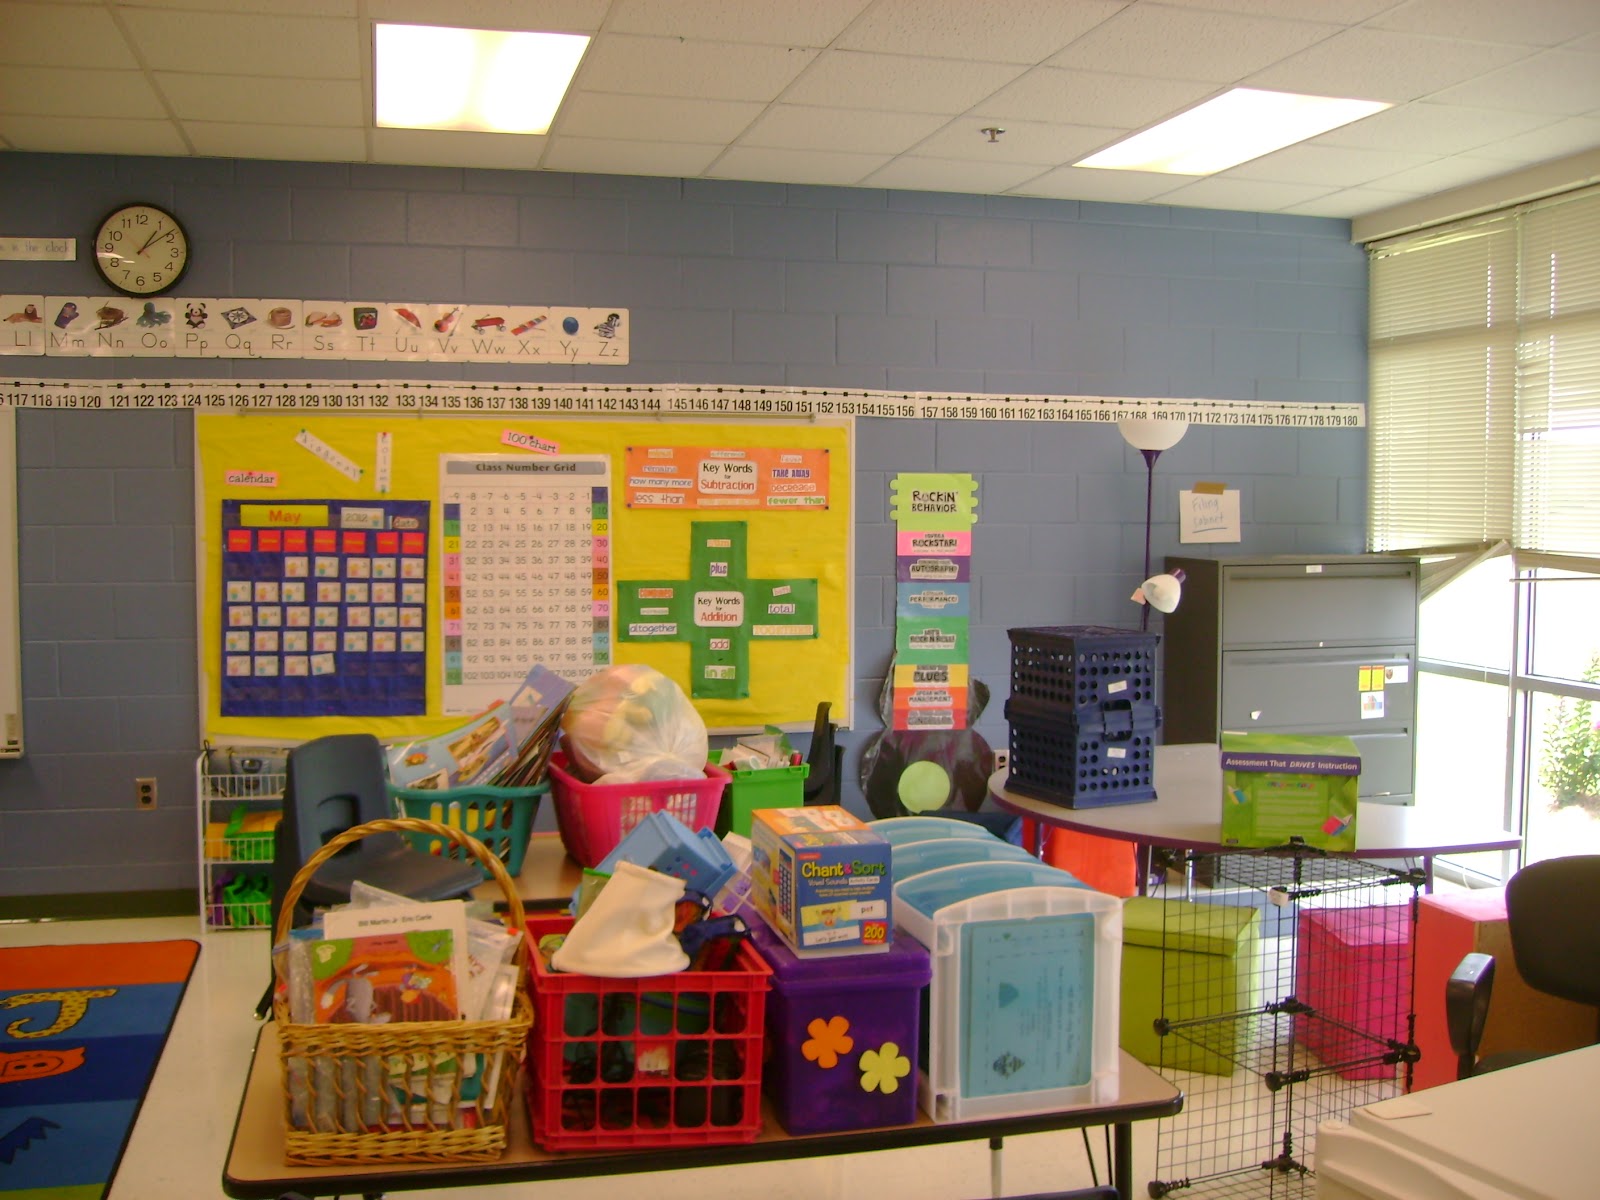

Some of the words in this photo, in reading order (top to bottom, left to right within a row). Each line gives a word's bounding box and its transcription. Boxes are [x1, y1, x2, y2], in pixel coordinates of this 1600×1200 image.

[122, 218, 132, 228] 11
[136, 214, 148, 225] 12
[158, 220, 162, 230] 1
[109, 231, 122, 242] 10
[166, 234, 174, 243] 2
[104, 243, 114, 252] 9
[170, 248, 178, 258] 3
[110, 258, 120, 268] 8
[165, 262, 173, 272] 4
[122, 270, 130, 280] 7
[153, 272, 162, 282] 5
[136, 276, 144, 286] 6
[15, 331, 32, 347] Ll
[50, 332, 84, 348] Mm
[98, 332, 124, 348] Nn
[141, 332, 168, 348] Oo
[186, 334, 208, 356] Pp
[225, 334, 255, 356] Qq
[272, 334, 292, 350] Rr
[314, 336, 334, 351] Ss
[356, 336, 376, 352] Tt
[395, 338, 418, 353] Uu
[438, 338, 458, 354] Vv
[472, 339, 506, 354] Ww
[517, 340, 540, 355] Xx
[560, 341, 578, 362] Yy
[599, 342, 619, 357] Zz
[111, 394, 130, 407] 121
[134, 394, 154, 407] 122
[158, 394, 178, 407] 123
[182, 394, 201, 407] 124
[205, 394, 225, 407] 125
[229, 394, 249, 407] 126
[252, 394, 272, 407] 127
[276, 394, 296, 407] 128
[299, 394, 319, 407] 129
[322, 395, 342, 407] 130
[346, 395, 364, 408] 131
[369, 395, 388, 408] 132
[396, 396, 415, 408] 133
[418, 396, 438, 408] 134
[442, 396, 463, 408] 135
[464, 396, 484, 409] 136
[486, 397, 506, 409] 137
[509, 397, 529, 409] 138
[532, 397, 551, 409] 139
[554, 398, 573, 410] 140
[576, 398, 594, 410] 141
[597, 398, 616, 410] 142
[620, 398, 639, 410] 143
[641, 399, 661, 411] 144
[668, 399, 688, 411] 145
[689, 399, 709, 411] 146
[711, 400, 730, 412] 147
[732, 400, 751, 412] 148
[754, 400, 772, 412] 149
[775, 400, 793, 413] 150
[796, 401, 814, 413] 151
[816, 402, 834, 414] 152
[836, 402, 855, 415] 153
[856, 403, 875, 416] 154
[876, 404, 895, 417] 155
[896, 405, 915, 417] 156
[1258, 413, 1273, 425] 175
[1275, 414, 1291, 425] 176
[1292, 414, 1308, 426] 177
[1309, 414, 1325, 426] 178
[1326, 415, 1342, 426] 179
[1342, 415, 1358, 427] 180
[507, 432, 527, 445] 100
[530, 438, 556, 453] chart
[476, 463, 502, 472] Class
[506, 463, 549, 472] Number
[554, 463, 576, 472] Grid
[703, 463, 720, 474] Key
[724, 464, 753, 473] Words
[772, 469, 789, 478] TAKE
[792, 469, 810, 478] AWAY
[228, 474, 275, 484] calendar
[701, 480, 754, 490] Subtraction
[661, 494, 684, 503] than
[1192, 496, 1219, 512] Filing
[269, 510, 301, 524] May
[710, 564, 727, 575] plus
[698, 597, 712, 606] Key
[715, 597, 740, 605] Words
[770, 604, 793, 613] total
[701, 612, 737, 621] Addition
[630, 624, 676, 634] altogether
[710, 640, 729, 649] add
[706, 667, 718, 678] in
[1226, 758, 1268, 767] Assessment
[1318, 762, 1357, 770] Instruction
[801, 862, 843, 877] Chant
[844, 864, 852, 874] &
[852, 860, 886, 875] Sort
[864, 926, 884, 938] 200
